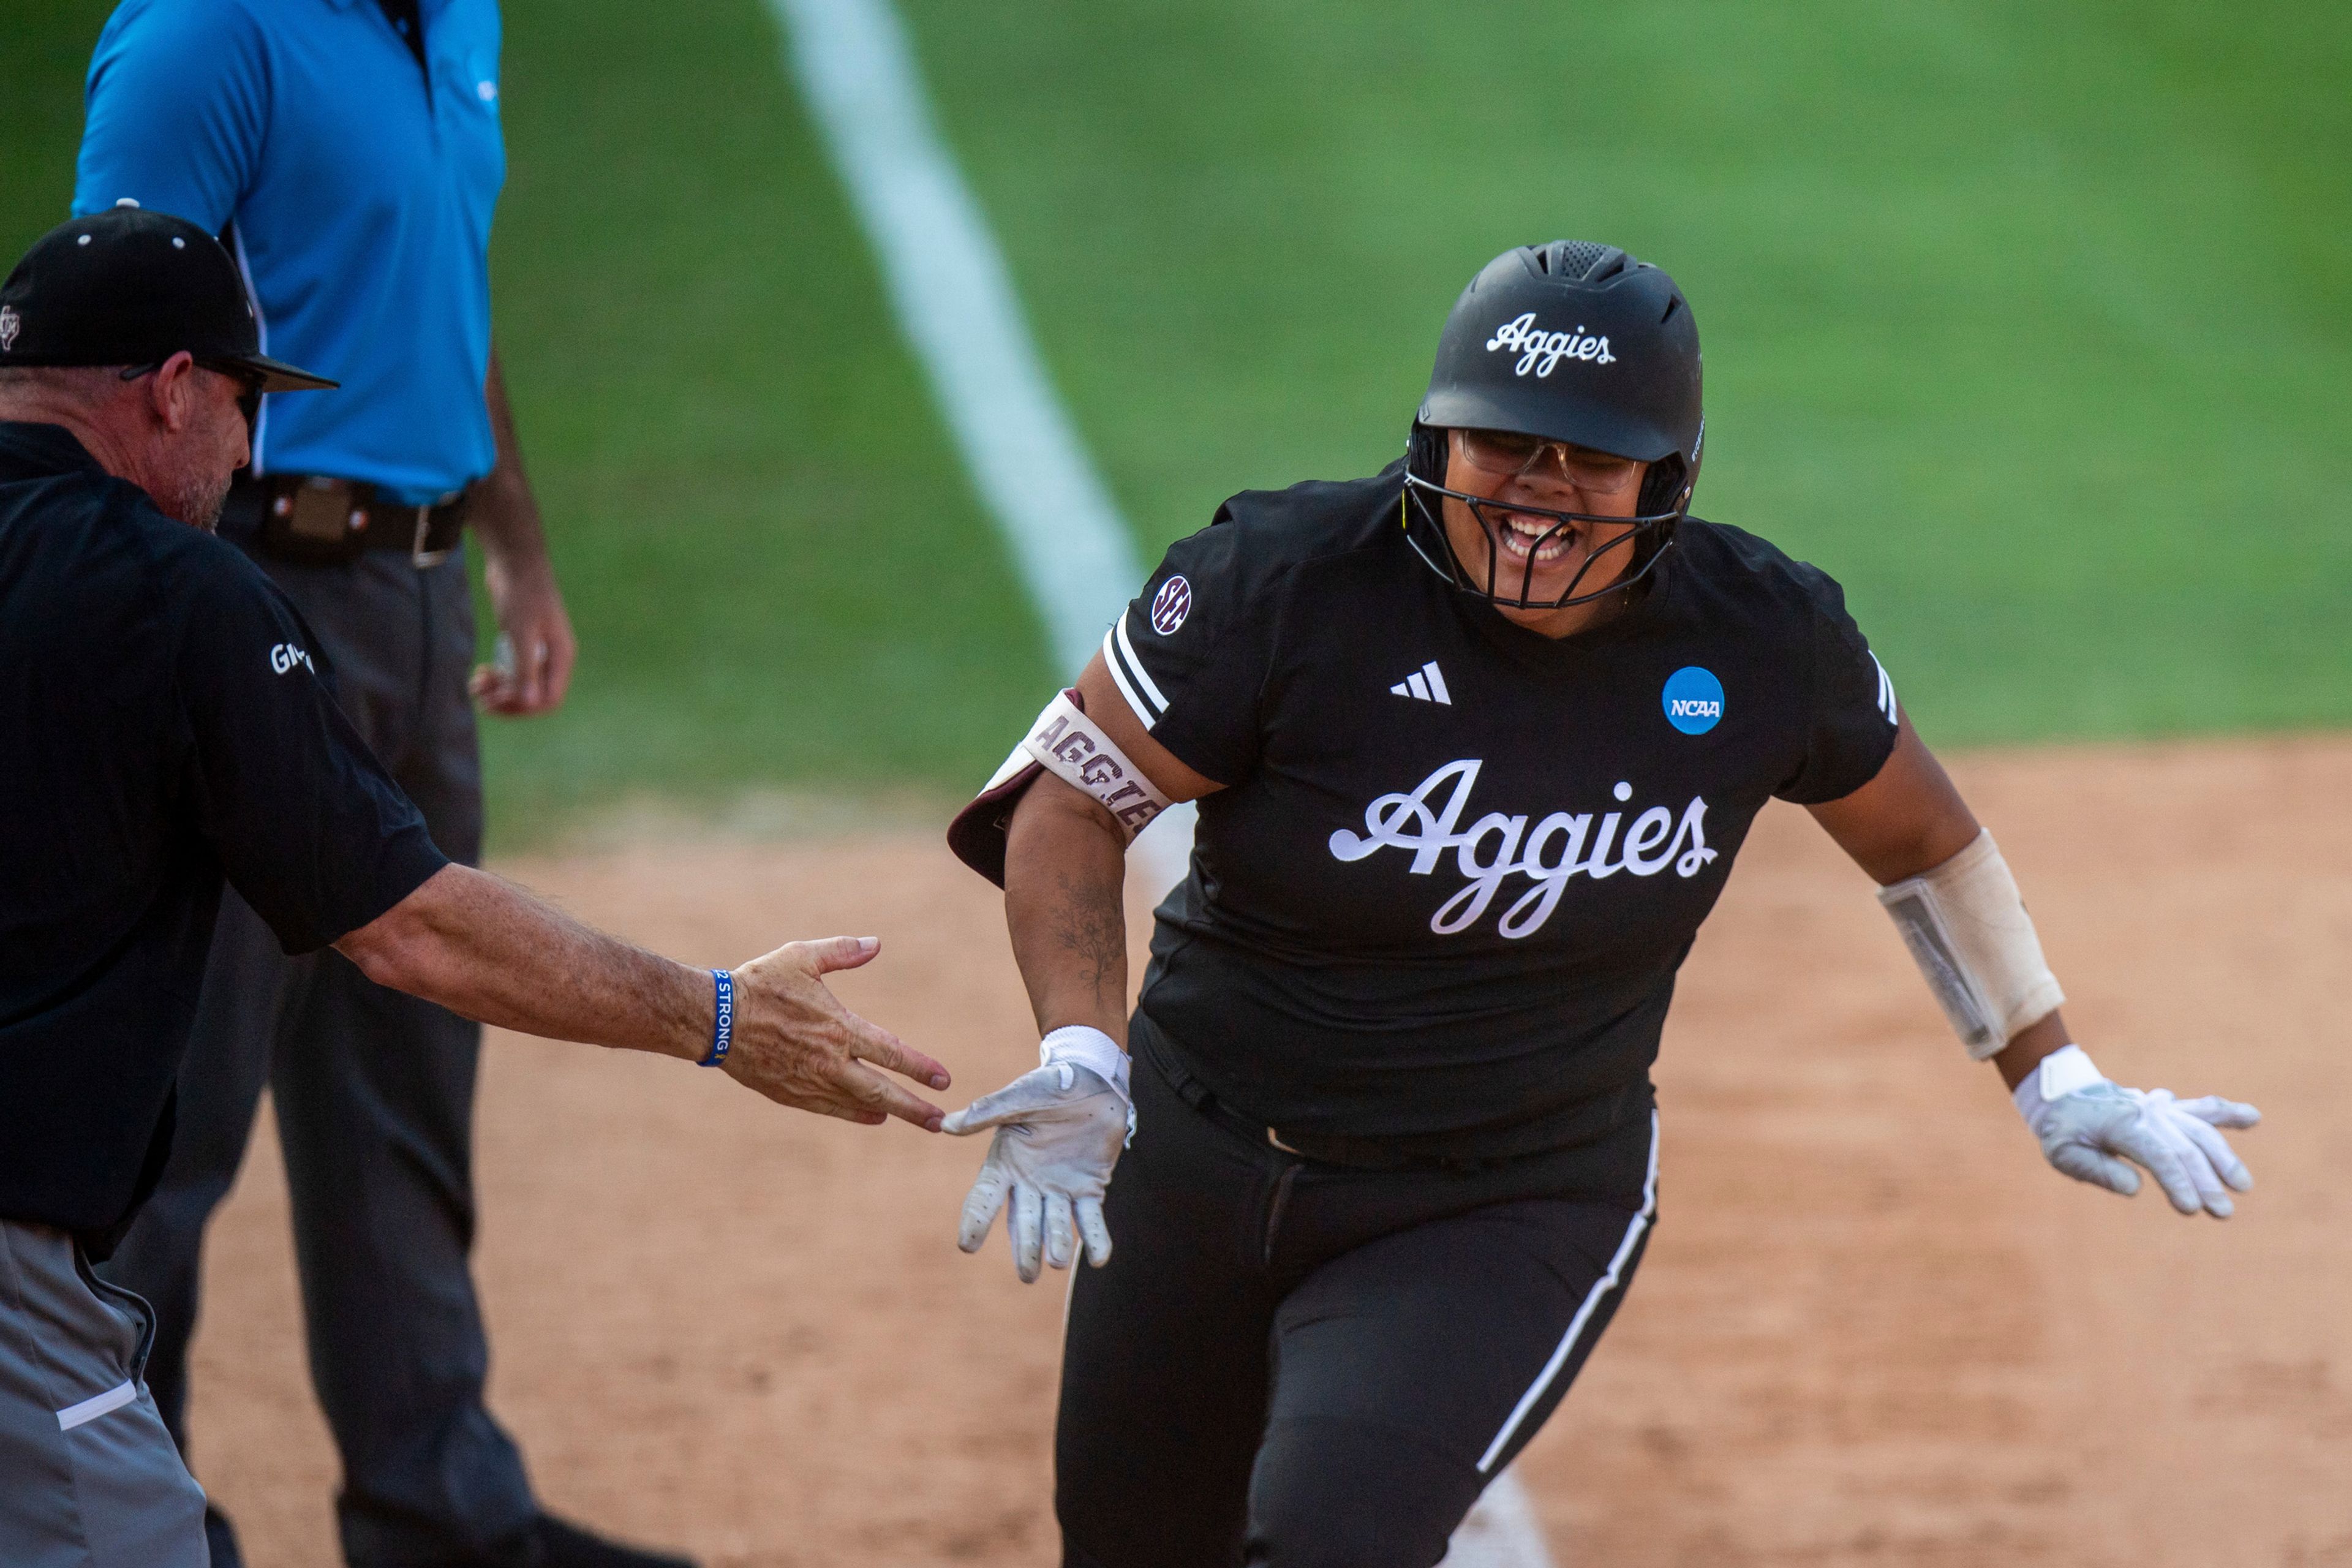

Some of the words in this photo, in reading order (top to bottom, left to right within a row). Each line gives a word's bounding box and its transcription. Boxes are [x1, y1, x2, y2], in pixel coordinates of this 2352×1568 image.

[1486, 313, 1616, 378] Aggies
[1154, 577, 1190, 633] SEC
[1671, 699, 1720, 718] NCAA
[1035, 715, 1163, 834] AGGIE
[1329, 759, 1719, 939] Aggies
[717, 982, 731, 1051] STRONG
